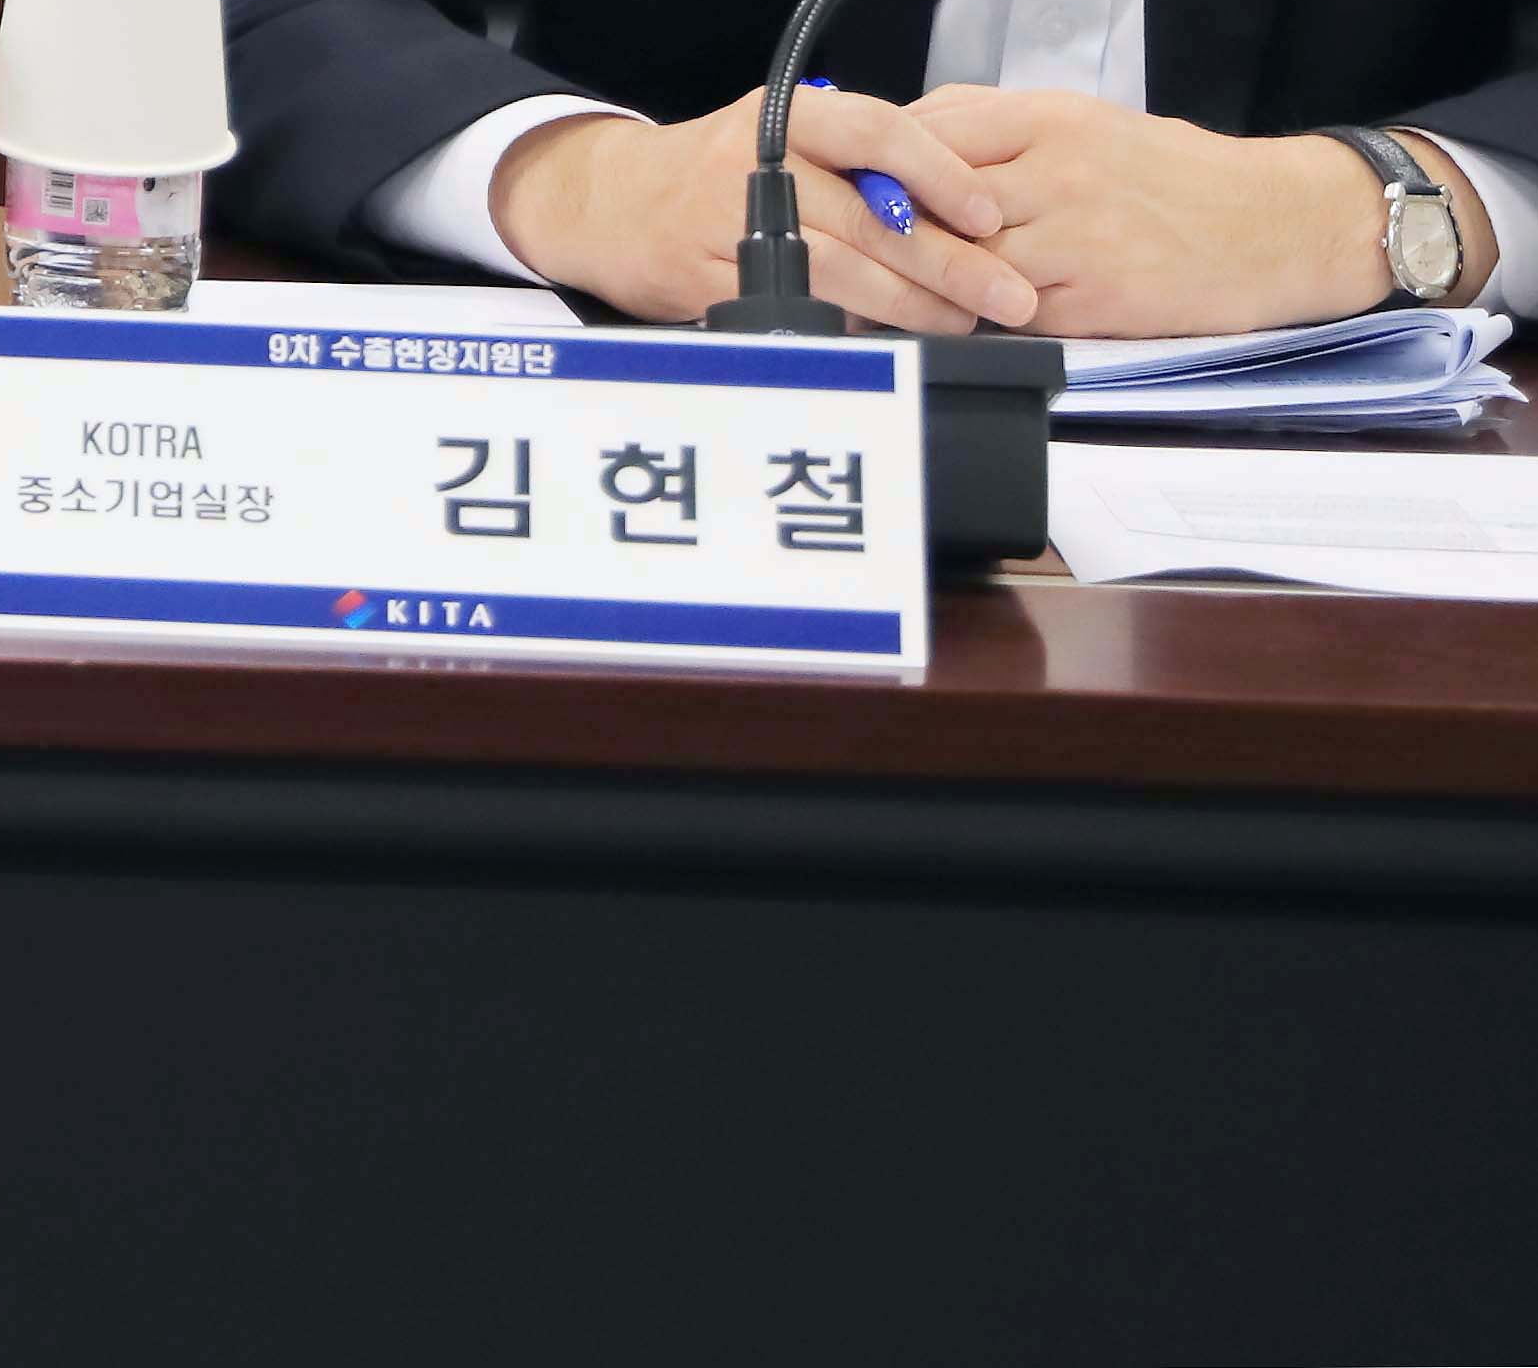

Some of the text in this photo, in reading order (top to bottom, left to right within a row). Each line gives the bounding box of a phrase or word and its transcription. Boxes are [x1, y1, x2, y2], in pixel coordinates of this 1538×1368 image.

[268, 332, 555, 375] 9차 수출현장지원단
[82, 420, 204, 459] KOTRA
[17, 475, 275, 523] 중소기업실장
[387, 599, 494, 628] KITA
